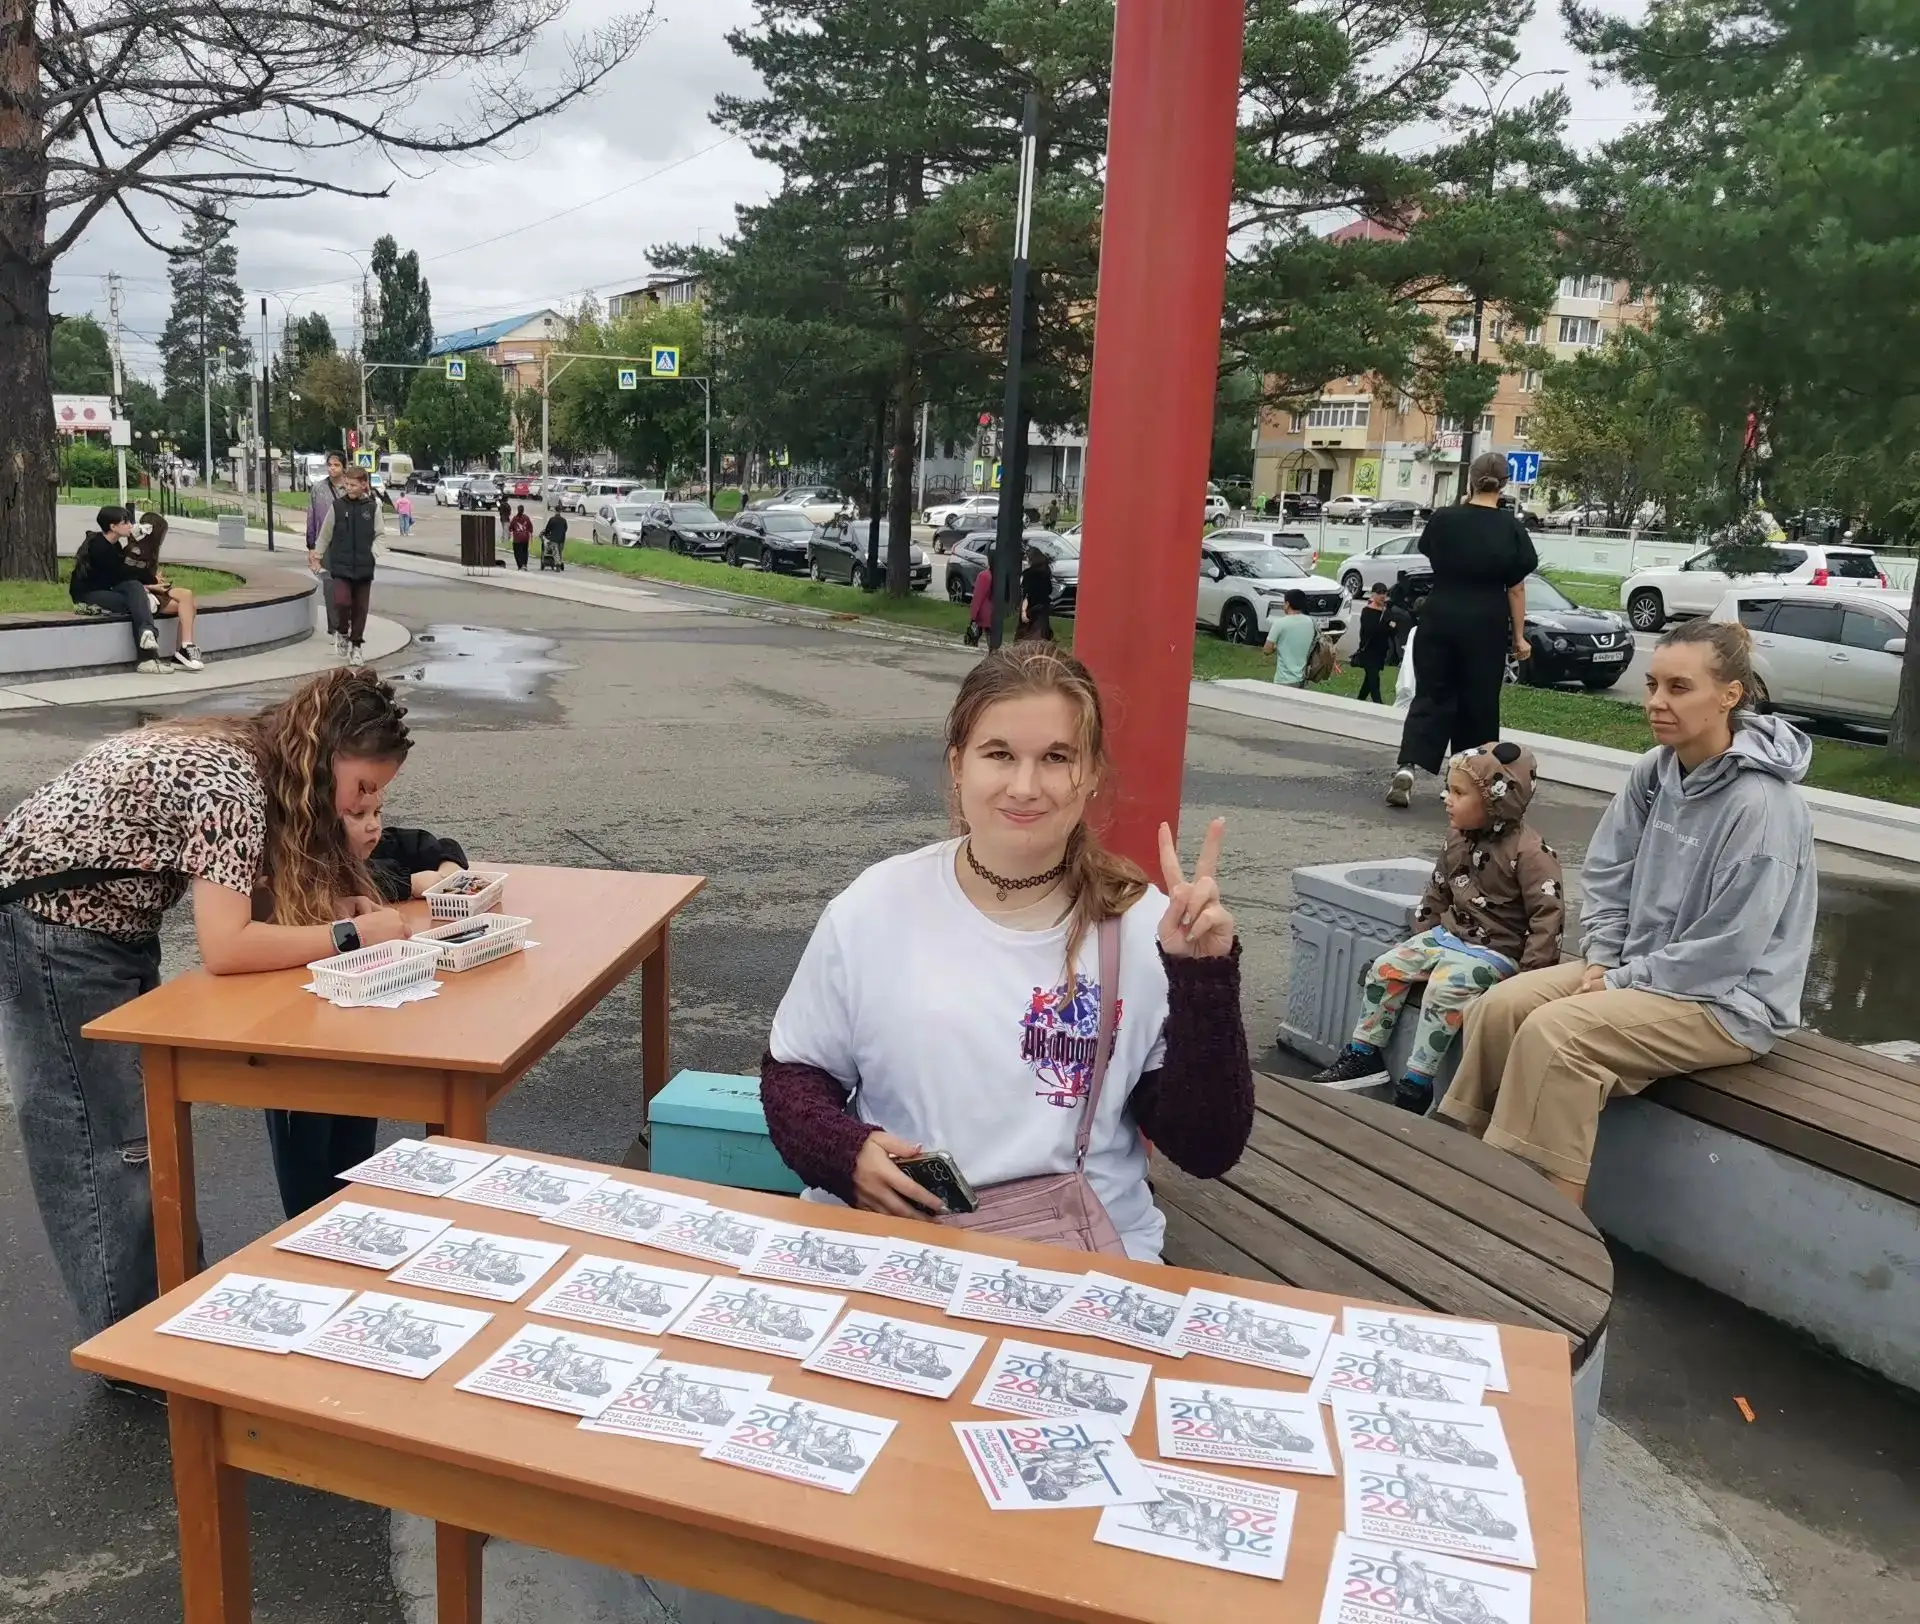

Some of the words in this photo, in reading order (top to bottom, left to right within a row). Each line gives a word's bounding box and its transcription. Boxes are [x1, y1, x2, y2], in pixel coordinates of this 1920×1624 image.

[322, 1218, 362, 1231] 20
[673, 1215, 713, 1228] 20
[306, 1228, 341, 1241] 26
[662, 1224, 696, 1239] 26
[430, 1245, 472, 1259] 20
[768, 1239, 805, 1252] 20
[417, 1256, 458, 1271] 26
[761, 1250, 798, 1262] 26
[883, 1255, 922, 1269] 20
[571, 1273, 612, 1288] 20
[875, 1266, 911, 1280] 26
[969, 1276, 1006, 1291] 20
[206, 1292, 250, 1308] 20
[558, 1285, 597, 1300] 26
[965, 1289, 1005, 1303] 26
[1081, 1289, 1122, 1306] 20
[706, 1295, 747, 1311] 20
[1069, 1300, 1110, 1318] 26
[191, 1305, 233, 1321] 26
[341, 1311, 386, 1328] 20
[696, 1308, 734, 1323] 26
[1190, 1307, 1232, 1324] 20
[325, 1323, 368, 1341] 26
[1183, 1320, 1224, 1337] 26
[1357, 1326, 1399, 1343] 20
[839, 1329, 881, 1346] 20
[505, 1344, 550, 1363] 20
[828, 1341, 869, 1358] 26
[490, 1358, 535, 1377] 26
[1002, 1360, 1044, 1378] 20
[1334, 1357, 1378, 1377] 20
[503, 1380, 558, 1395] ЕДИНСТВА
[995, 1374, 1037, 1393] 26
[1329, 1371, 1373, 1391] 26
[474, 1380, 524, 1393] НАРОДОВ
[526, 1391, 572, 1403] РОССИИ
[987, 1397, 1044, 1412] НАРОДОВ
[990, 1392, 1012, 1400] ГОД
[1017, 1398, 1078, 1413] ЕДИНСТВА
[1170, 1402, 1212, 1421] 20
[626, 1415, 686, 1428] ЕДИНСТВА
[742, 1410, 789, 1432] 20
[1172, 1420, 1218, 1438] 26
[1348, 1415, 1392, 1435] 20
[655, 1425, 703, 1436] РОССИИ
[730, 1425, 775, 1447] 26
[1040, 1425, 1082, 1450] 20
[1006, 1428, 1048, 1454] 26
[1204, 1444, 1271, 1455] ЕДИНСТВА
[1350, 1432, 1400, 1452] 26
[720, 1445, 744, 1455] ГОД
[747, 1451, 809, 1471] ЕДИНСТВА
[972, 1429, 994, 1459] НАРОДОВ
[990, 1460, 1008, 1488] РОССИИ
[984, 1428, 997, 1442] ГОД
[991, 1443, 1015, 1477] ЕДИНСТВА
[1175, 1446, 1236, 1456] НАРОДОВ
[1240, 1452, 1292, 1462] РОССИИ
[716, 1450, 772, 1469] НАРОДОВ
[776, 1464, 826, 1480] РОССИИ
[1158, 1473, 1212, 1488] РОССИИ
[1359, 1475, 1409, 1499] 20
[1179, 1484, 1247, 1502] ЕДИНСТВА
[1217, 1485, 1279, 1502] НАРОДОВ
[1253, 1498, 1279, 1508] ГОД
[1360, 1494, 1411, 1517] 26
[1227, 1509, 1276, 1533] 26
[1362, 1519, 1390, 1528] ГОД
[1394, 1523, 1468, 1541] ЕДИНСТВА
[1362, 1525, 1429, 1541] НАРОДОВ
[1433, 1536, 1493, 1550] РОССИИ
[1225, 1527, 1274, 1552] 20
[1348, 1559, 1400, 1586] 20
[1343, 1578, 1397, 1606] 26
[1341, 1606, 1369, 1618] ГОД
